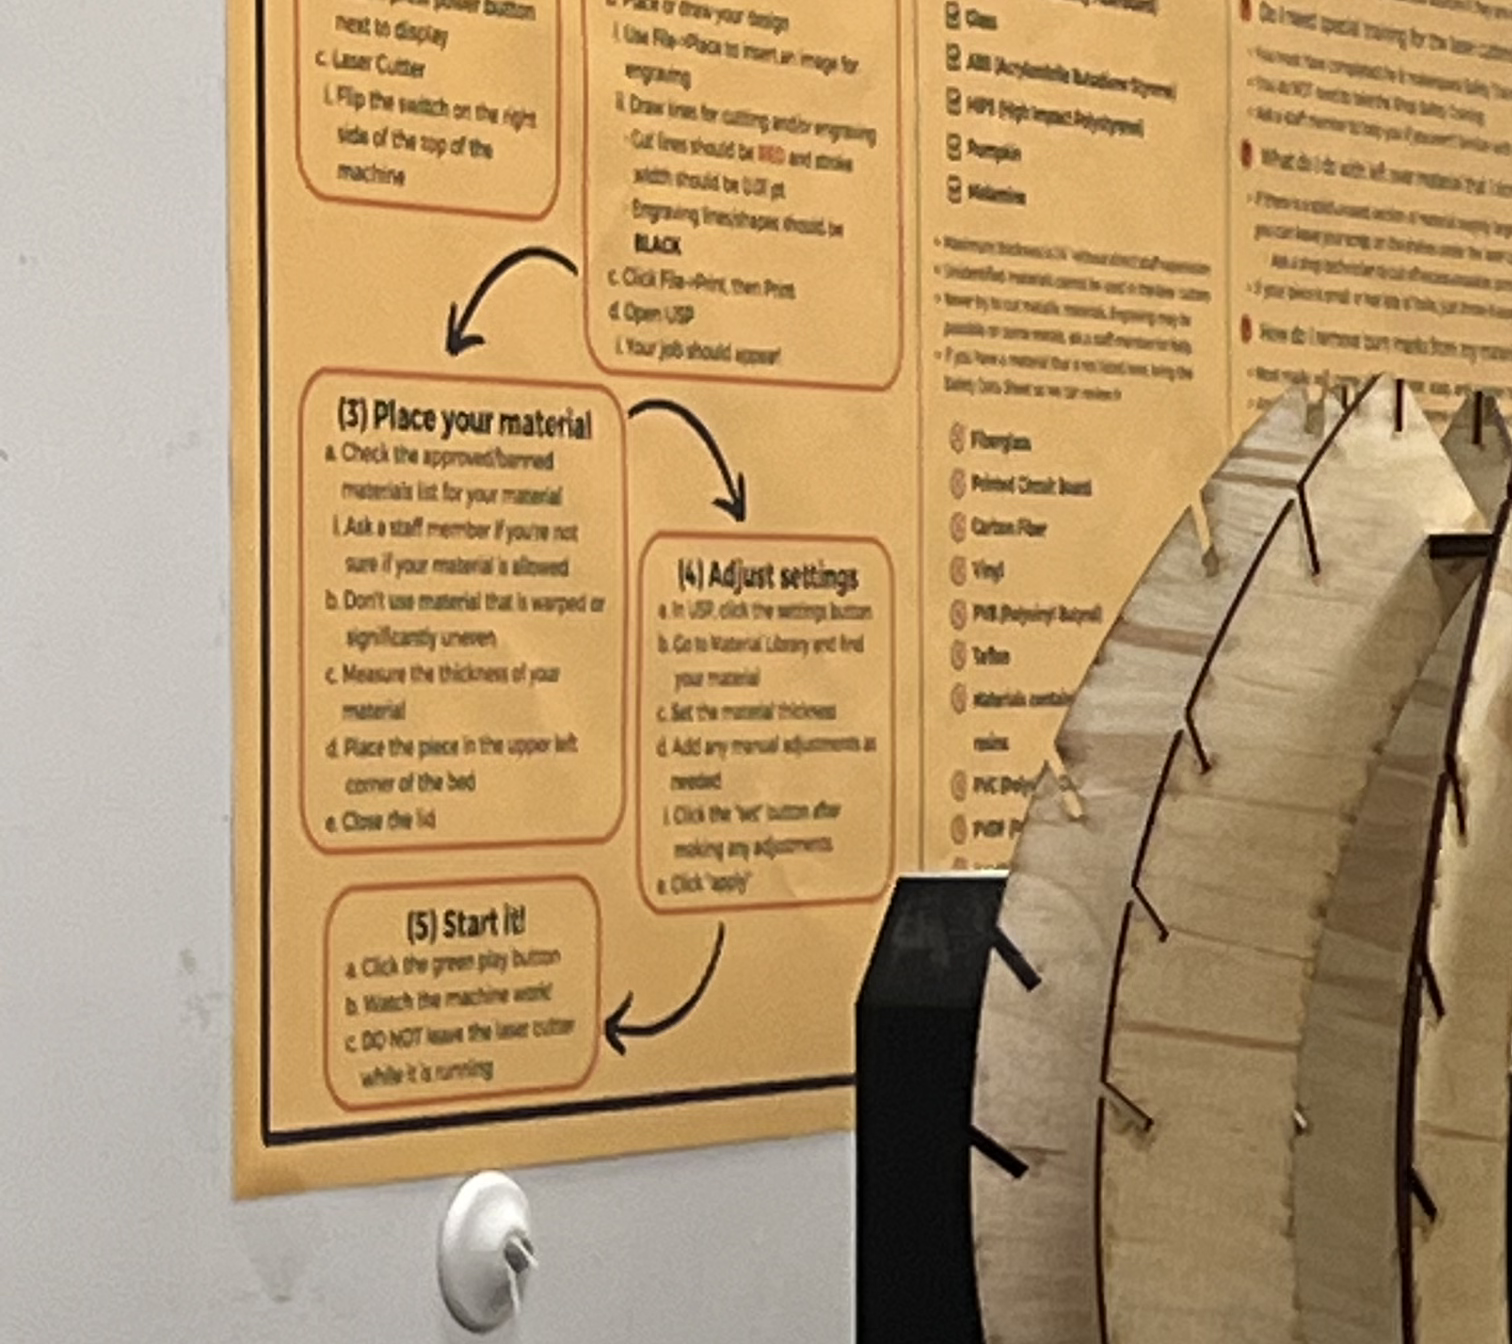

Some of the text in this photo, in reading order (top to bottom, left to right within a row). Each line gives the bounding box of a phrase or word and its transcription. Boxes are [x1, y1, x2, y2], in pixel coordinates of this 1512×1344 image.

[633, 232, 681, 255] BLACK
[337, 396, 592, 440] (3) Place your material
[677, 558, 858, 596] (4) Adjust settings
[406, 902, 526, 945] (5) Start it!
